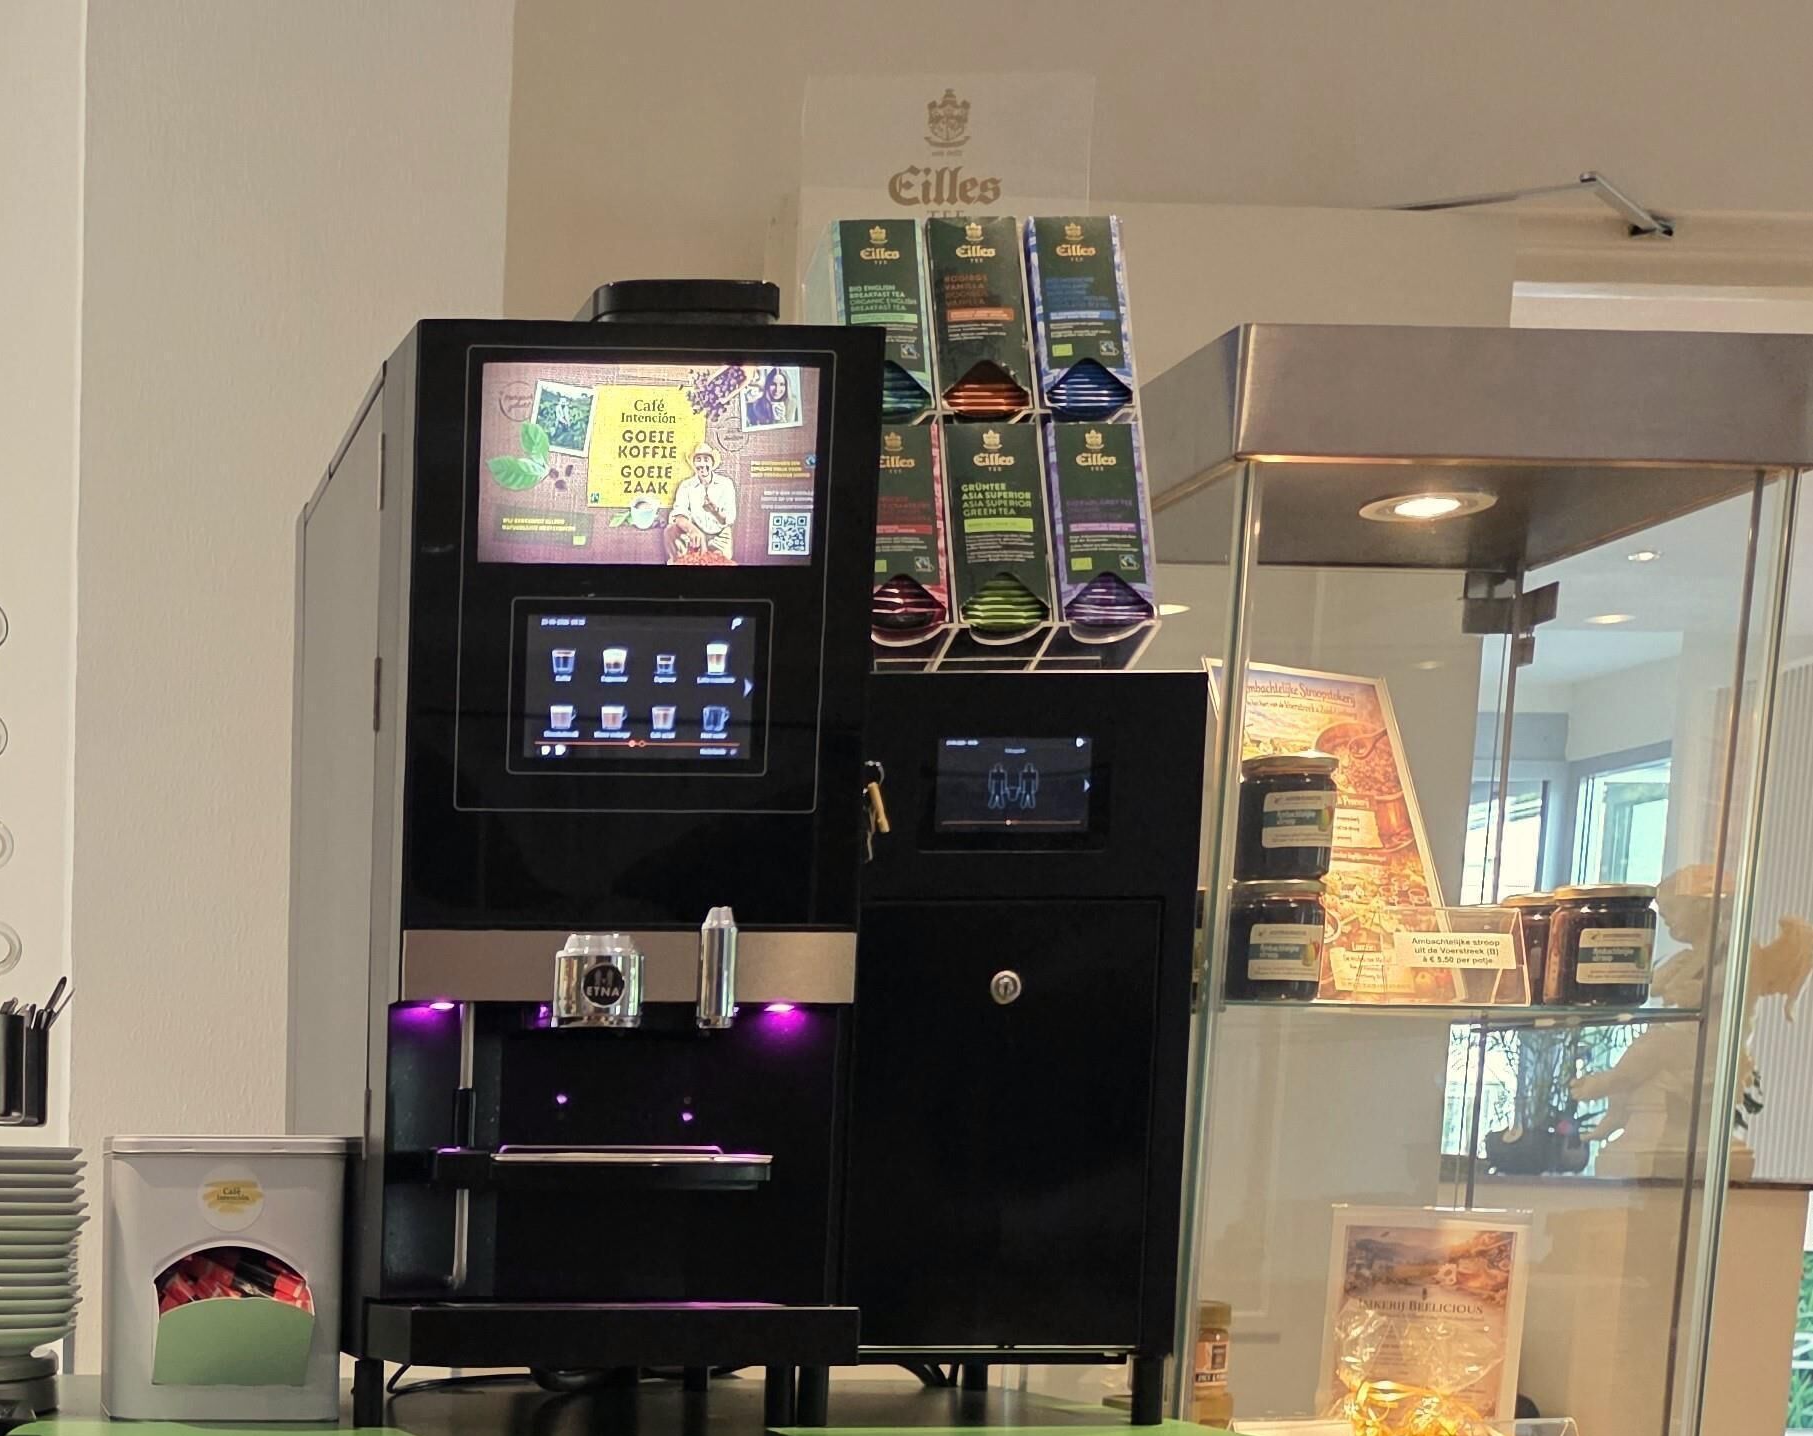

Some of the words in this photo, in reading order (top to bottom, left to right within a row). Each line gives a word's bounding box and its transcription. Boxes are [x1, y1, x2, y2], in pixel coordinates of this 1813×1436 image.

[888, 165, 1003, 206] Eilles
[634, 399, 665, 412] Café
[620, 412, 676, 424] Intención
[622, 430, 675, 444] GOEIE
[618, 446, 677, 459] KOFFIE
[620, 465, 673, 479] GOEIE
[623, 481, 668, 494] ZAAK
[961, 482, 1006, 492] GRÜNTEE
[961, 491, 983, 500] ASIA
[984, 491, 1032, 499] SUPERIOR
[962, 500, 984, 509] ASIA
[985, 500, 1032, 508] SUPERIOR
[963, 508, 997, 517] GREEN
[998, 507, 1016, 515] TEA
[1412, 937, 1470, 948] Ambachtelijke
[1472, 939, 1500, 947] stroop
[1439, 947, 1484, 955] Voerstreek
[1472, 957, 1493, 965] potje
[586, 986, 620, 997] ETNA
